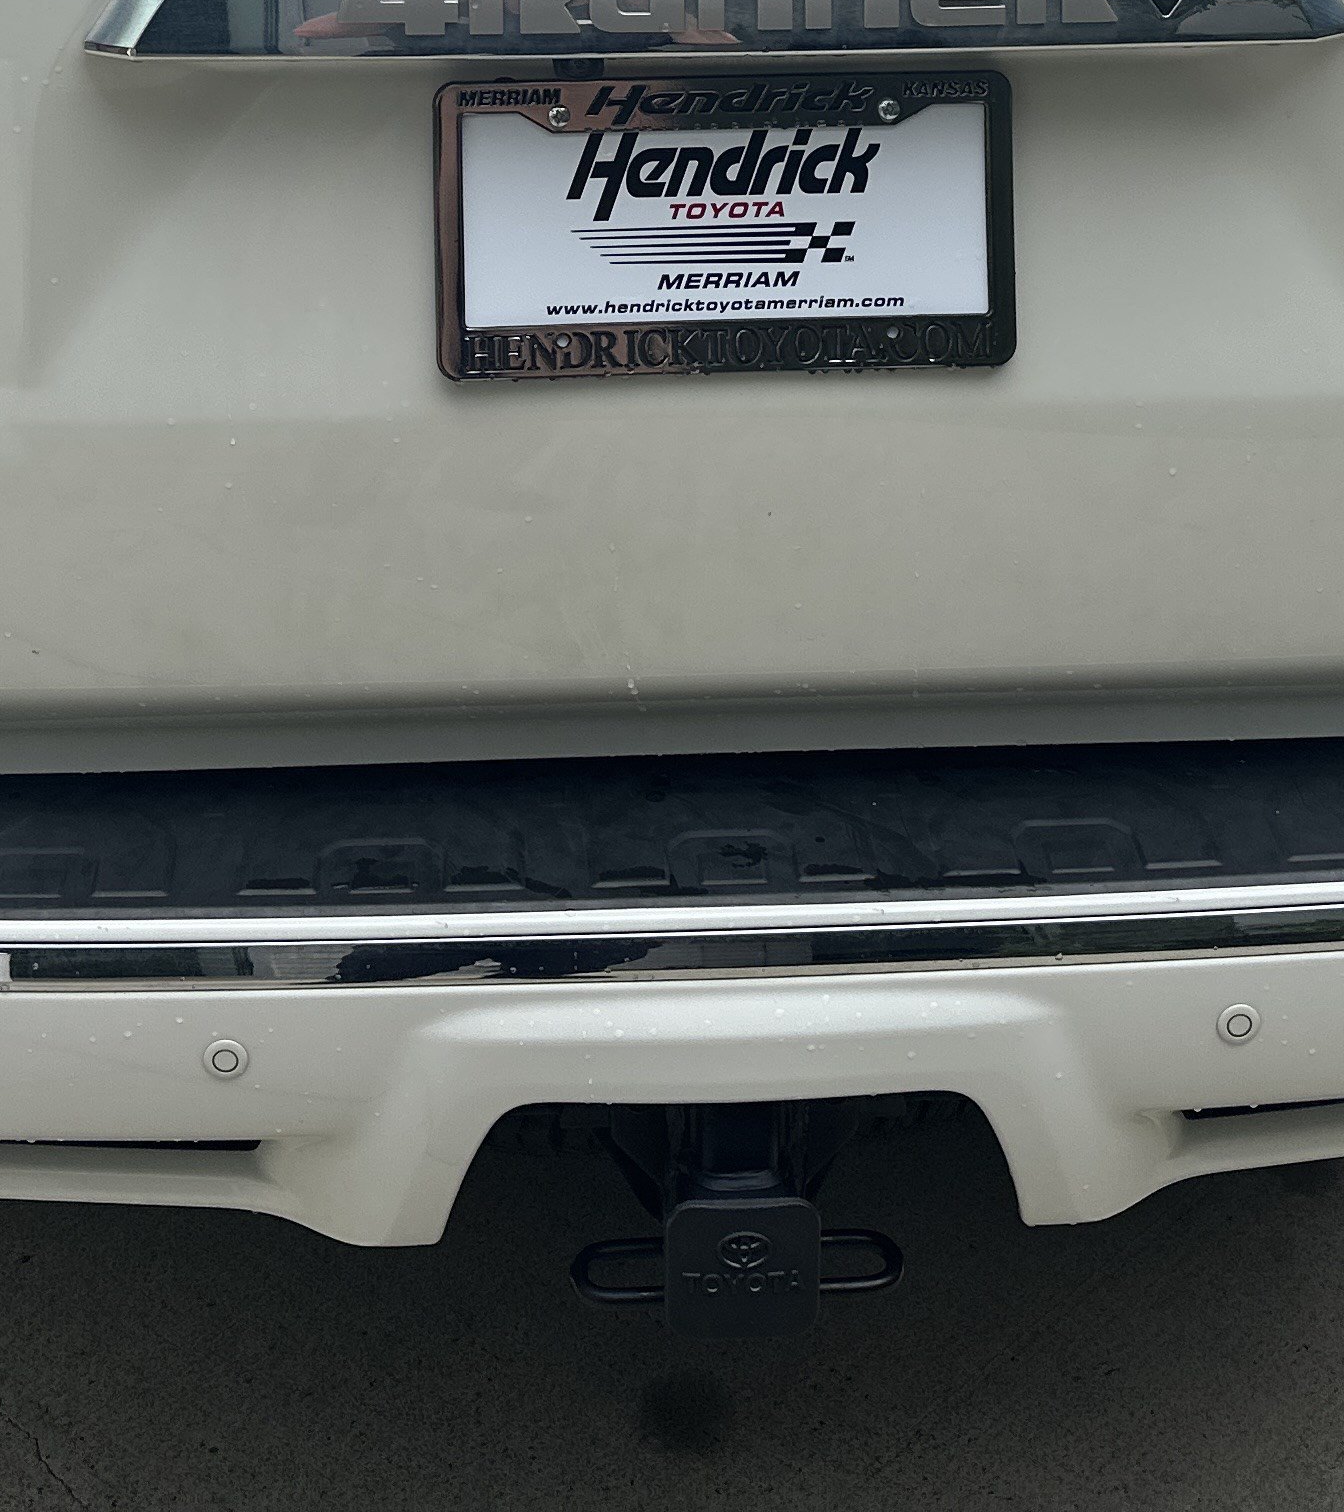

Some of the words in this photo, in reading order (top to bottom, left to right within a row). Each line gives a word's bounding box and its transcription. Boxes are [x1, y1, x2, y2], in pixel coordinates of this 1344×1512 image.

[458, 88, 562, 107] MERRIAM
[902, 79, 990, 97] KANSAS
[584, 81, 874, 127] Hendrick
[566, 128, 882, 222] Hendrick
[669, 201, 786, 220] TOYOTA
[657, 271, 801, 290] MERRIAM
[546, 295, 905, 316] www.hendricktoyotamerriam.com
